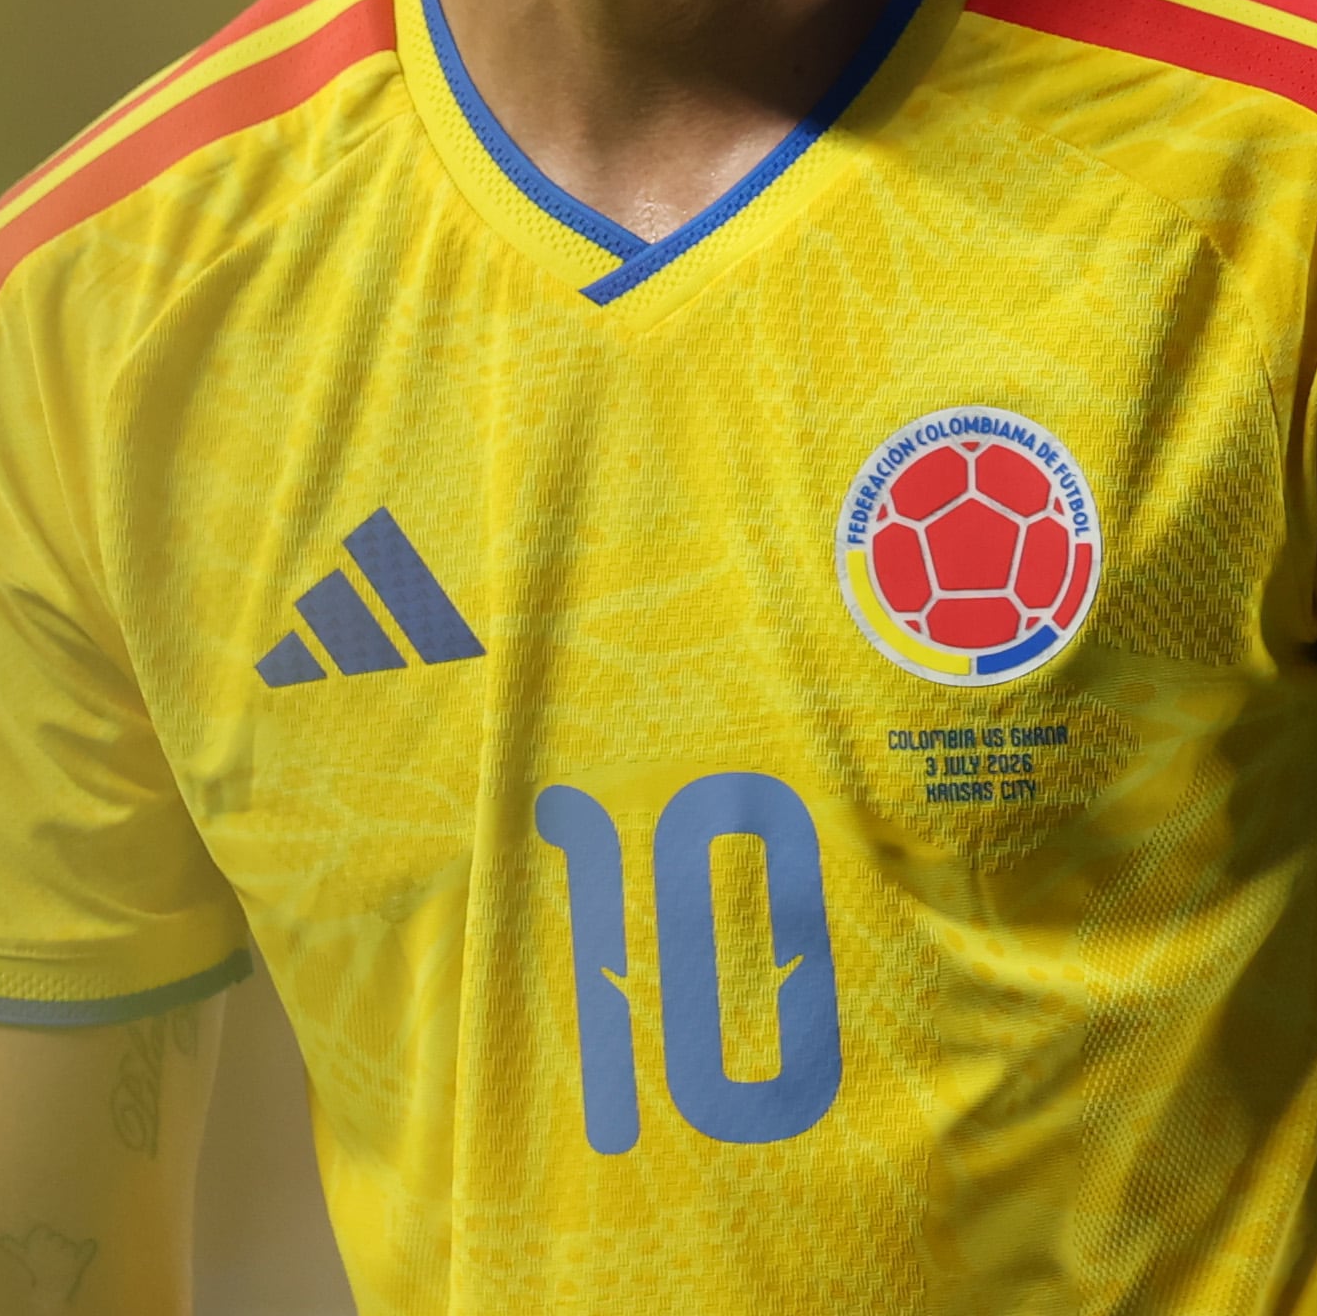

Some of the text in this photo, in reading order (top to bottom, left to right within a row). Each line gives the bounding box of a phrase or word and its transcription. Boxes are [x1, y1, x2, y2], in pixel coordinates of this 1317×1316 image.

[847, 416, 1090, 544] FEDERACIÓN COLOMBIANA DE FÚTBOL
[888, 728, 976, 750] COLOMBIA
[1010, 725, 1068, 748] GHANA
[925, 753, 1034, 777] 3 JULY 2026
[926, 779, 1037, 803] KANSAS CITY
[534, 771, 844, 1156] 10
